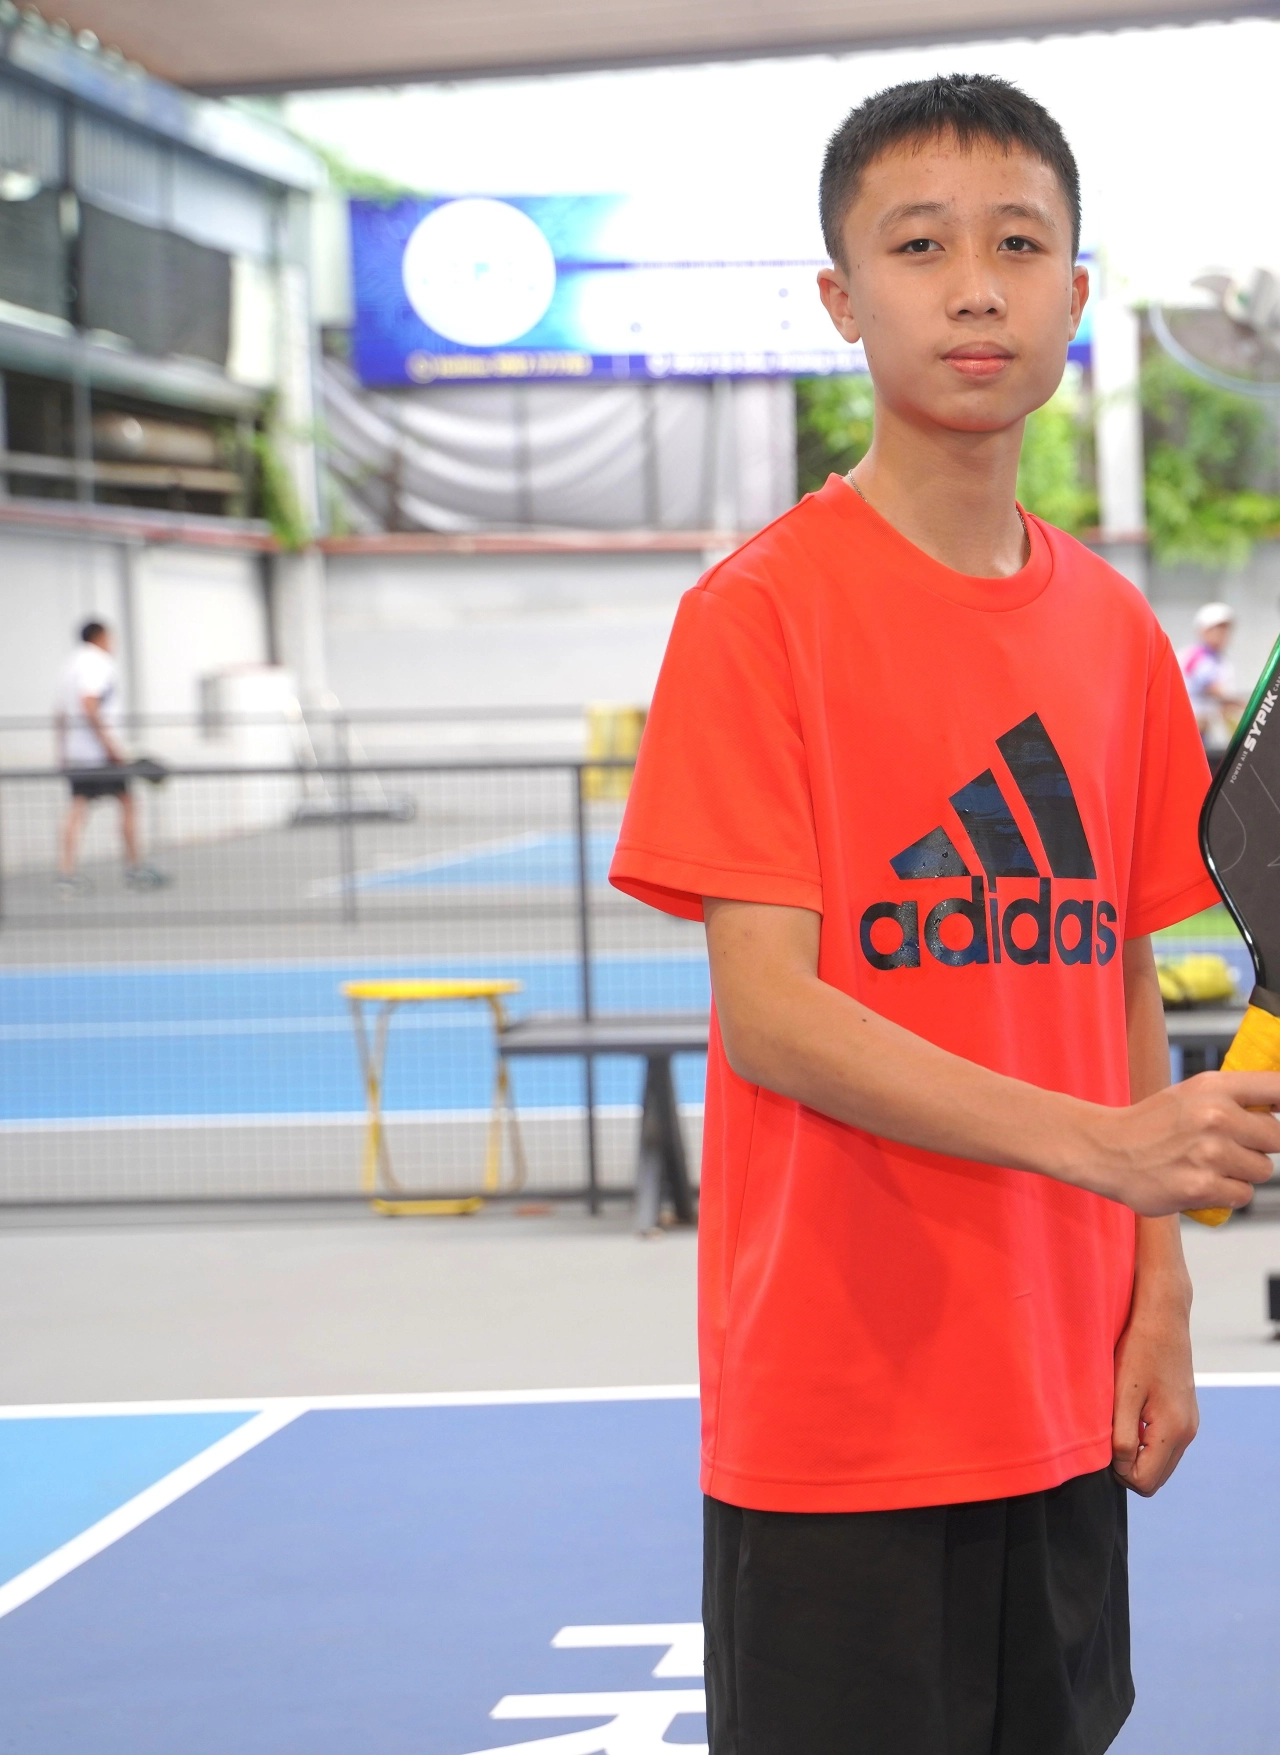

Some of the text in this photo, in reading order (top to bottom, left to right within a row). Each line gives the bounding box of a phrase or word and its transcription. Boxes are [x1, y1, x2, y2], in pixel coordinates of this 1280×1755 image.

[1243, 690, 1278, 752] SYPIK
[1230, 763, 1243, 784] POWER
[1240, 751, 1249, 763] AIR
[859, 876, 1117, 970] adidas
